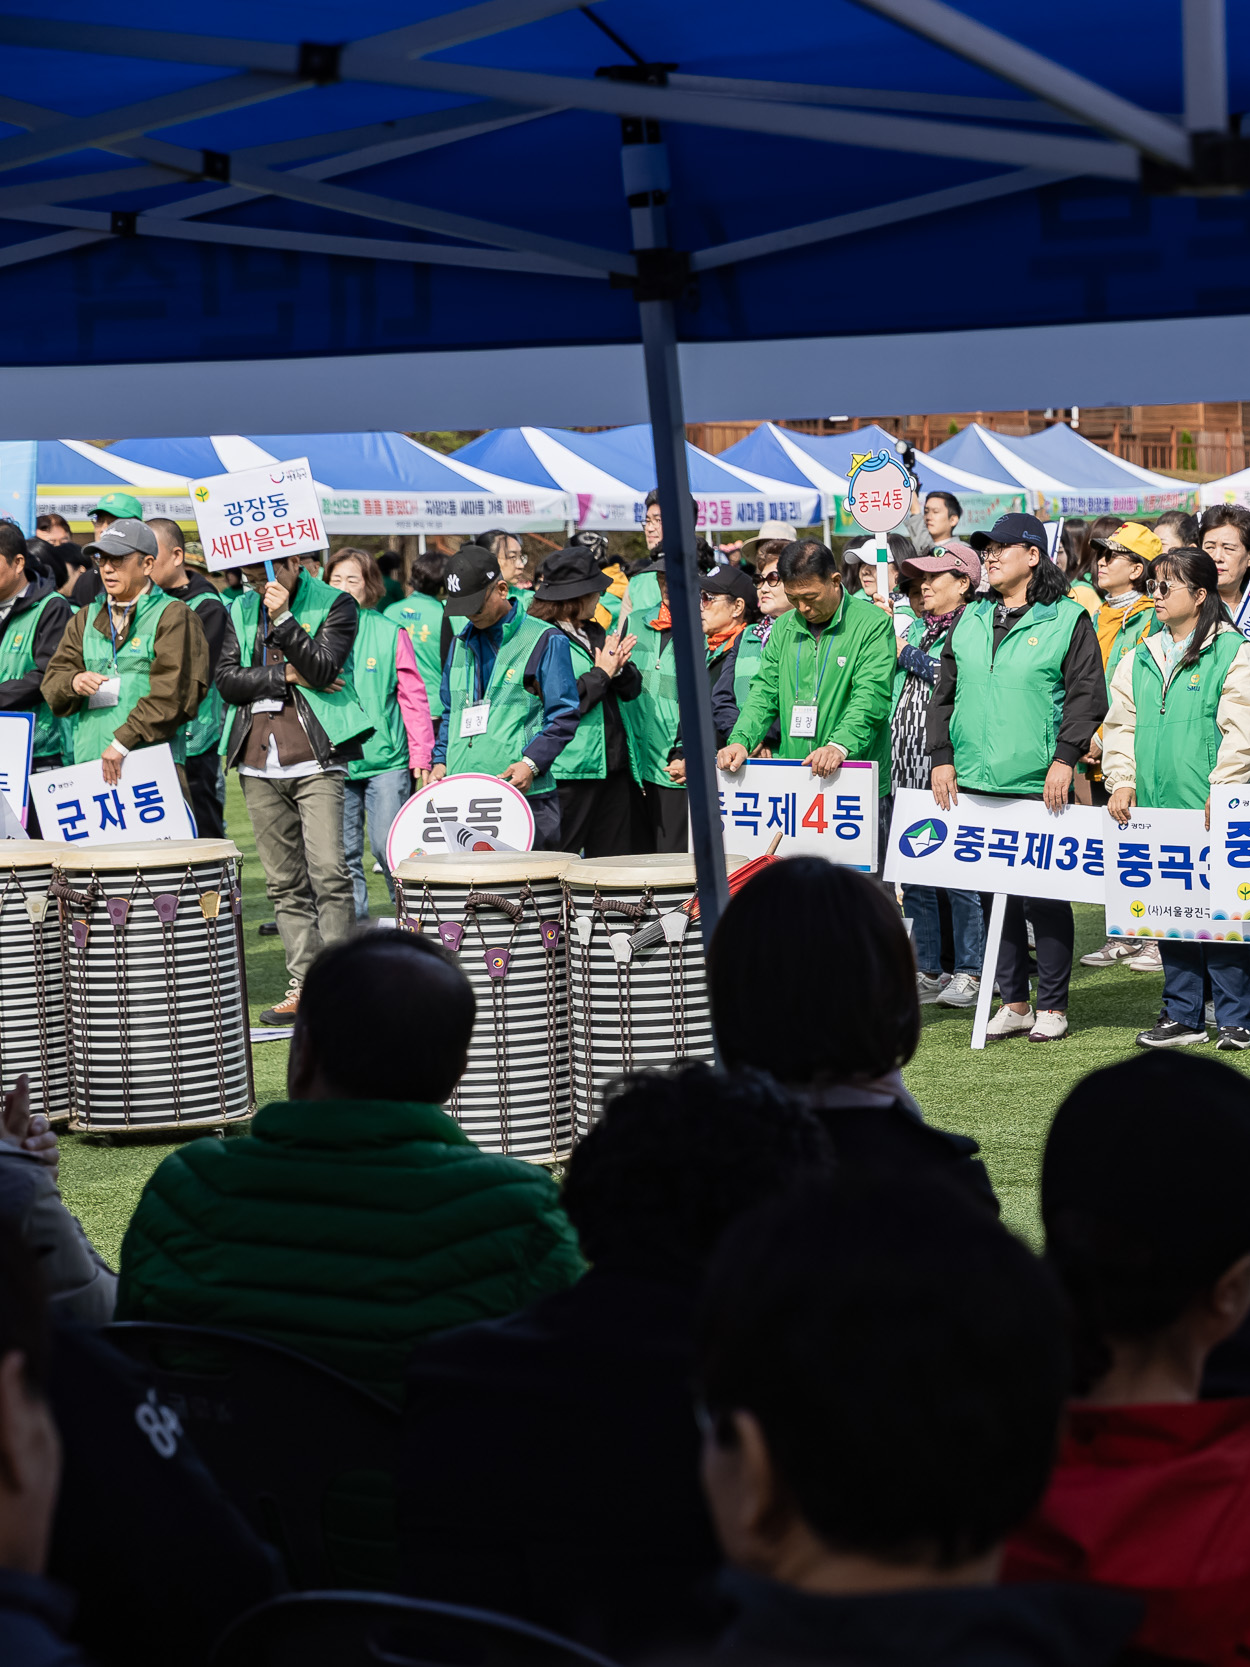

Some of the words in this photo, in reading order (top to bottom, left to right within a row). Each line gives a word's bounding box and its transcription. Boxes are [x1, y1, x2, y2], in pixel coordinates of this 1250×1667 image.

[223, 493, 290, 527] 광장동
[859, 489, 903, 513] 중곡4동
[211, 517, 320, 560] 새마을단체
[55, 780, 166, 842] 군자동
[421, 797, 503, 843] 능동
[718, 791, 864, 840] 곡제4동
[1130, 822, 1152, 830] 광진구
[954, 825, 1105, 877] 중곡제3동
